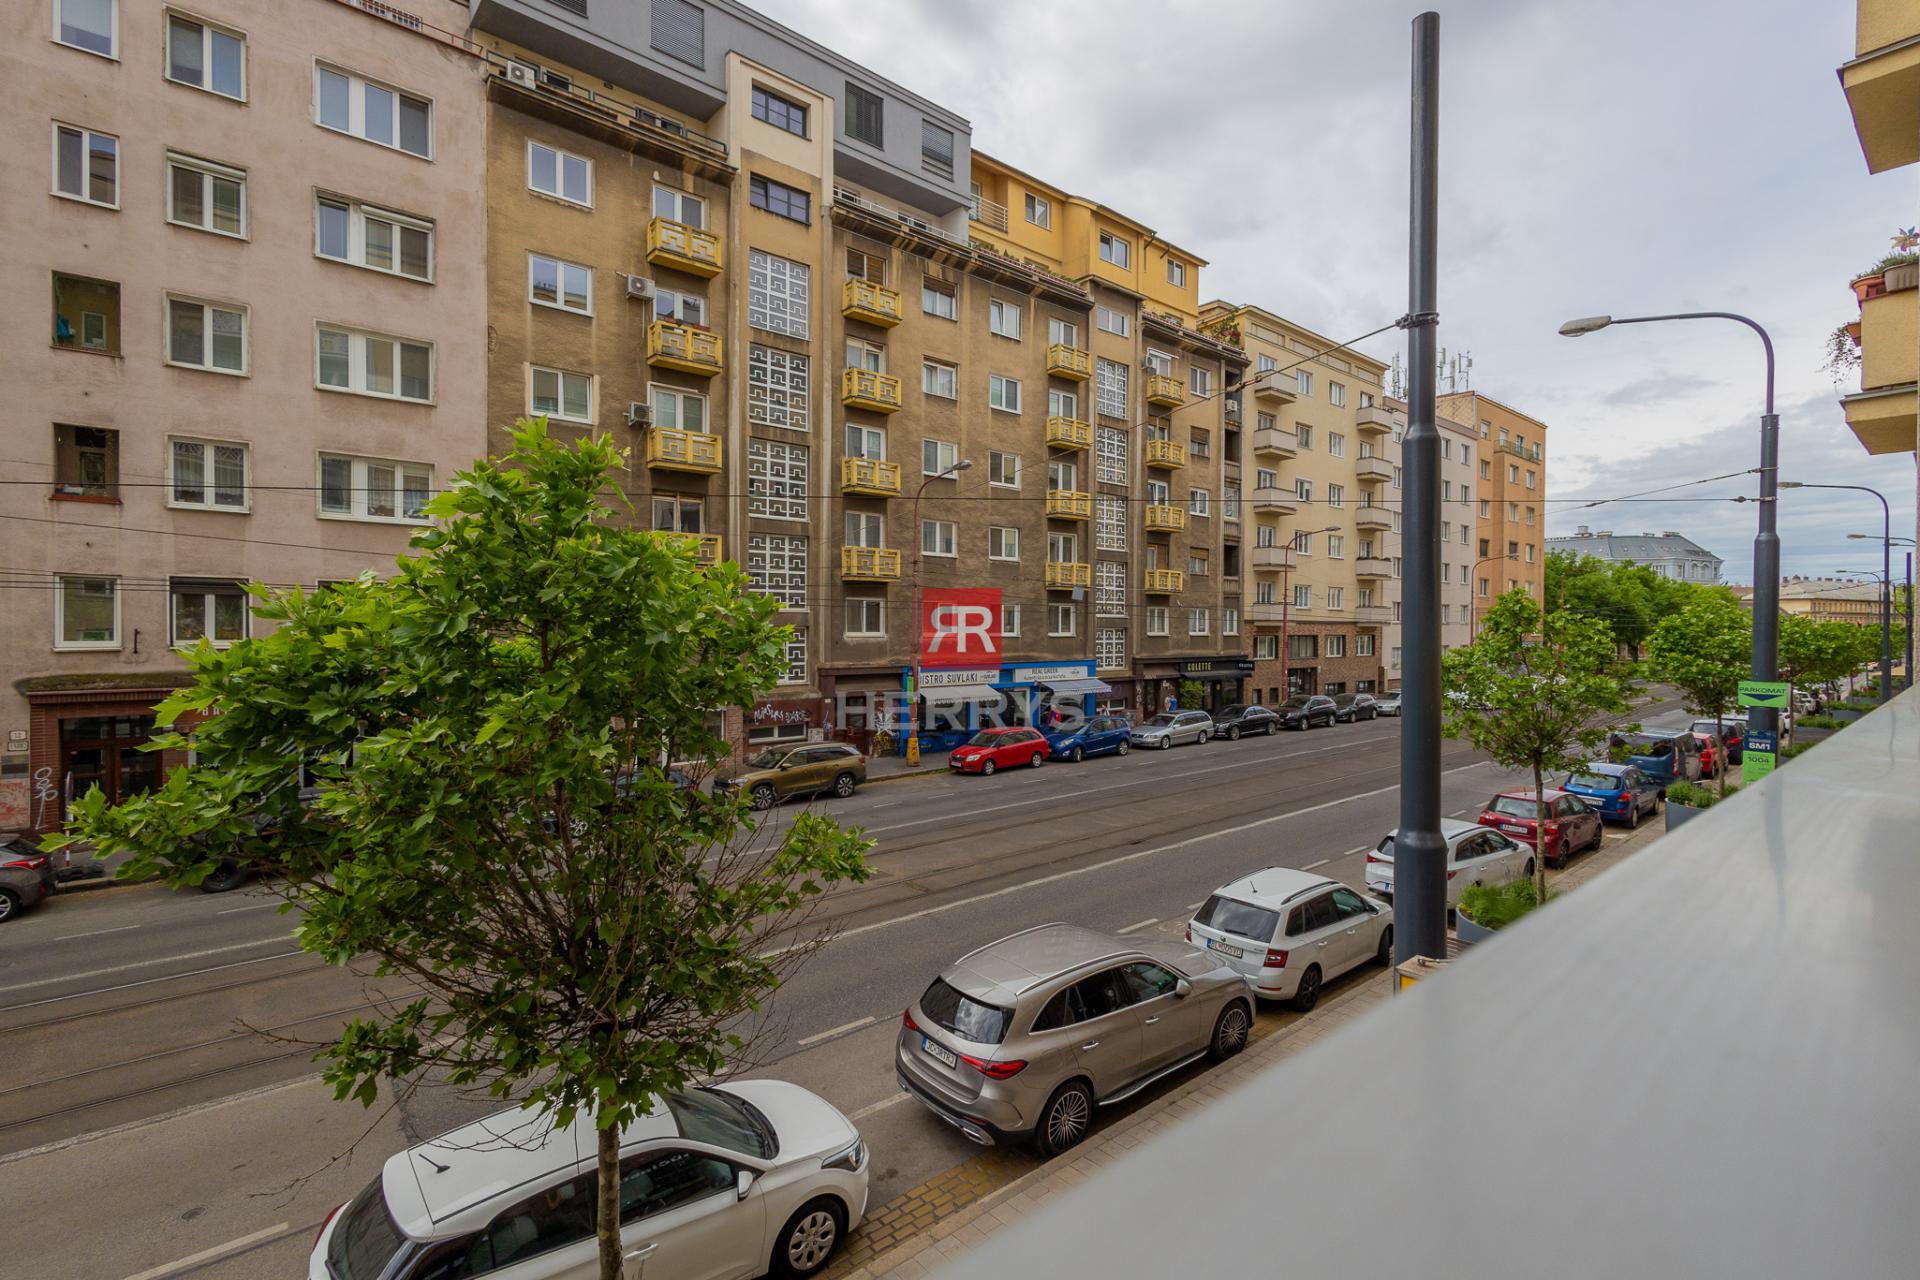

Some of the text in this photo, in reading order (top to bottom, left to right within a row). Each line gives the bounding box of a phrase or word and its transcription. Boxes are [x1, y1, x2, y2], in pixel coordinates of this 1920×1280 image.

[1187, 662, 1212, 671] COLETTE
[946, 673, 978, 684] SUVLAKI
[1748, 742, 1771, 750] SM1
